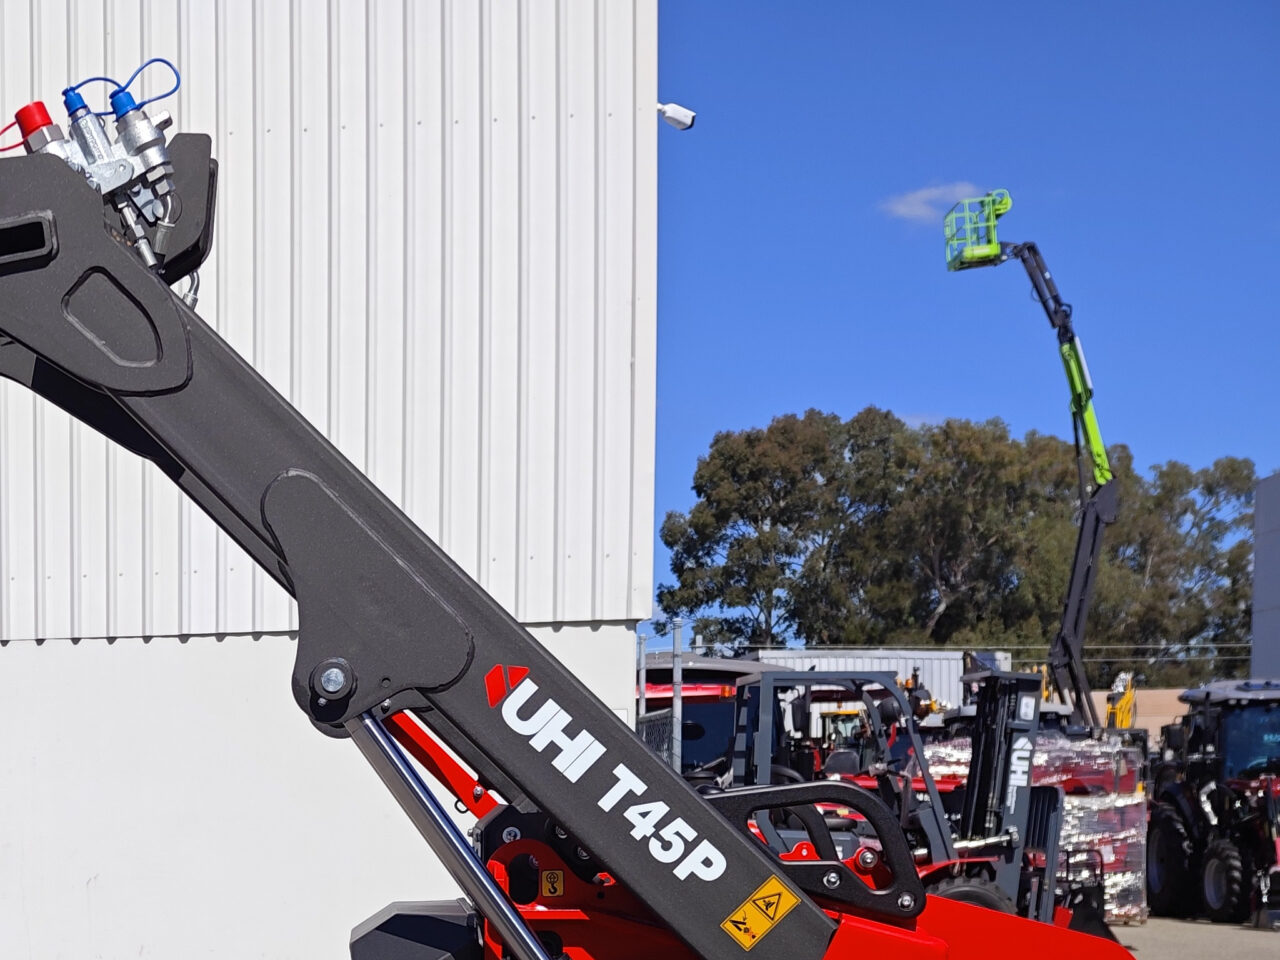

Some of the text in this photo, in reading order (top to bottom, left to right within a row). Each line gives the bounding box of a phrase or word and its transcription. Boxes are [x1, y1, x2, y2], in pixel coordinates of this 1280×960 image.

[502, 677, 727, 881] UHI T45P
[1009, 750, 1030, 786] UHI
